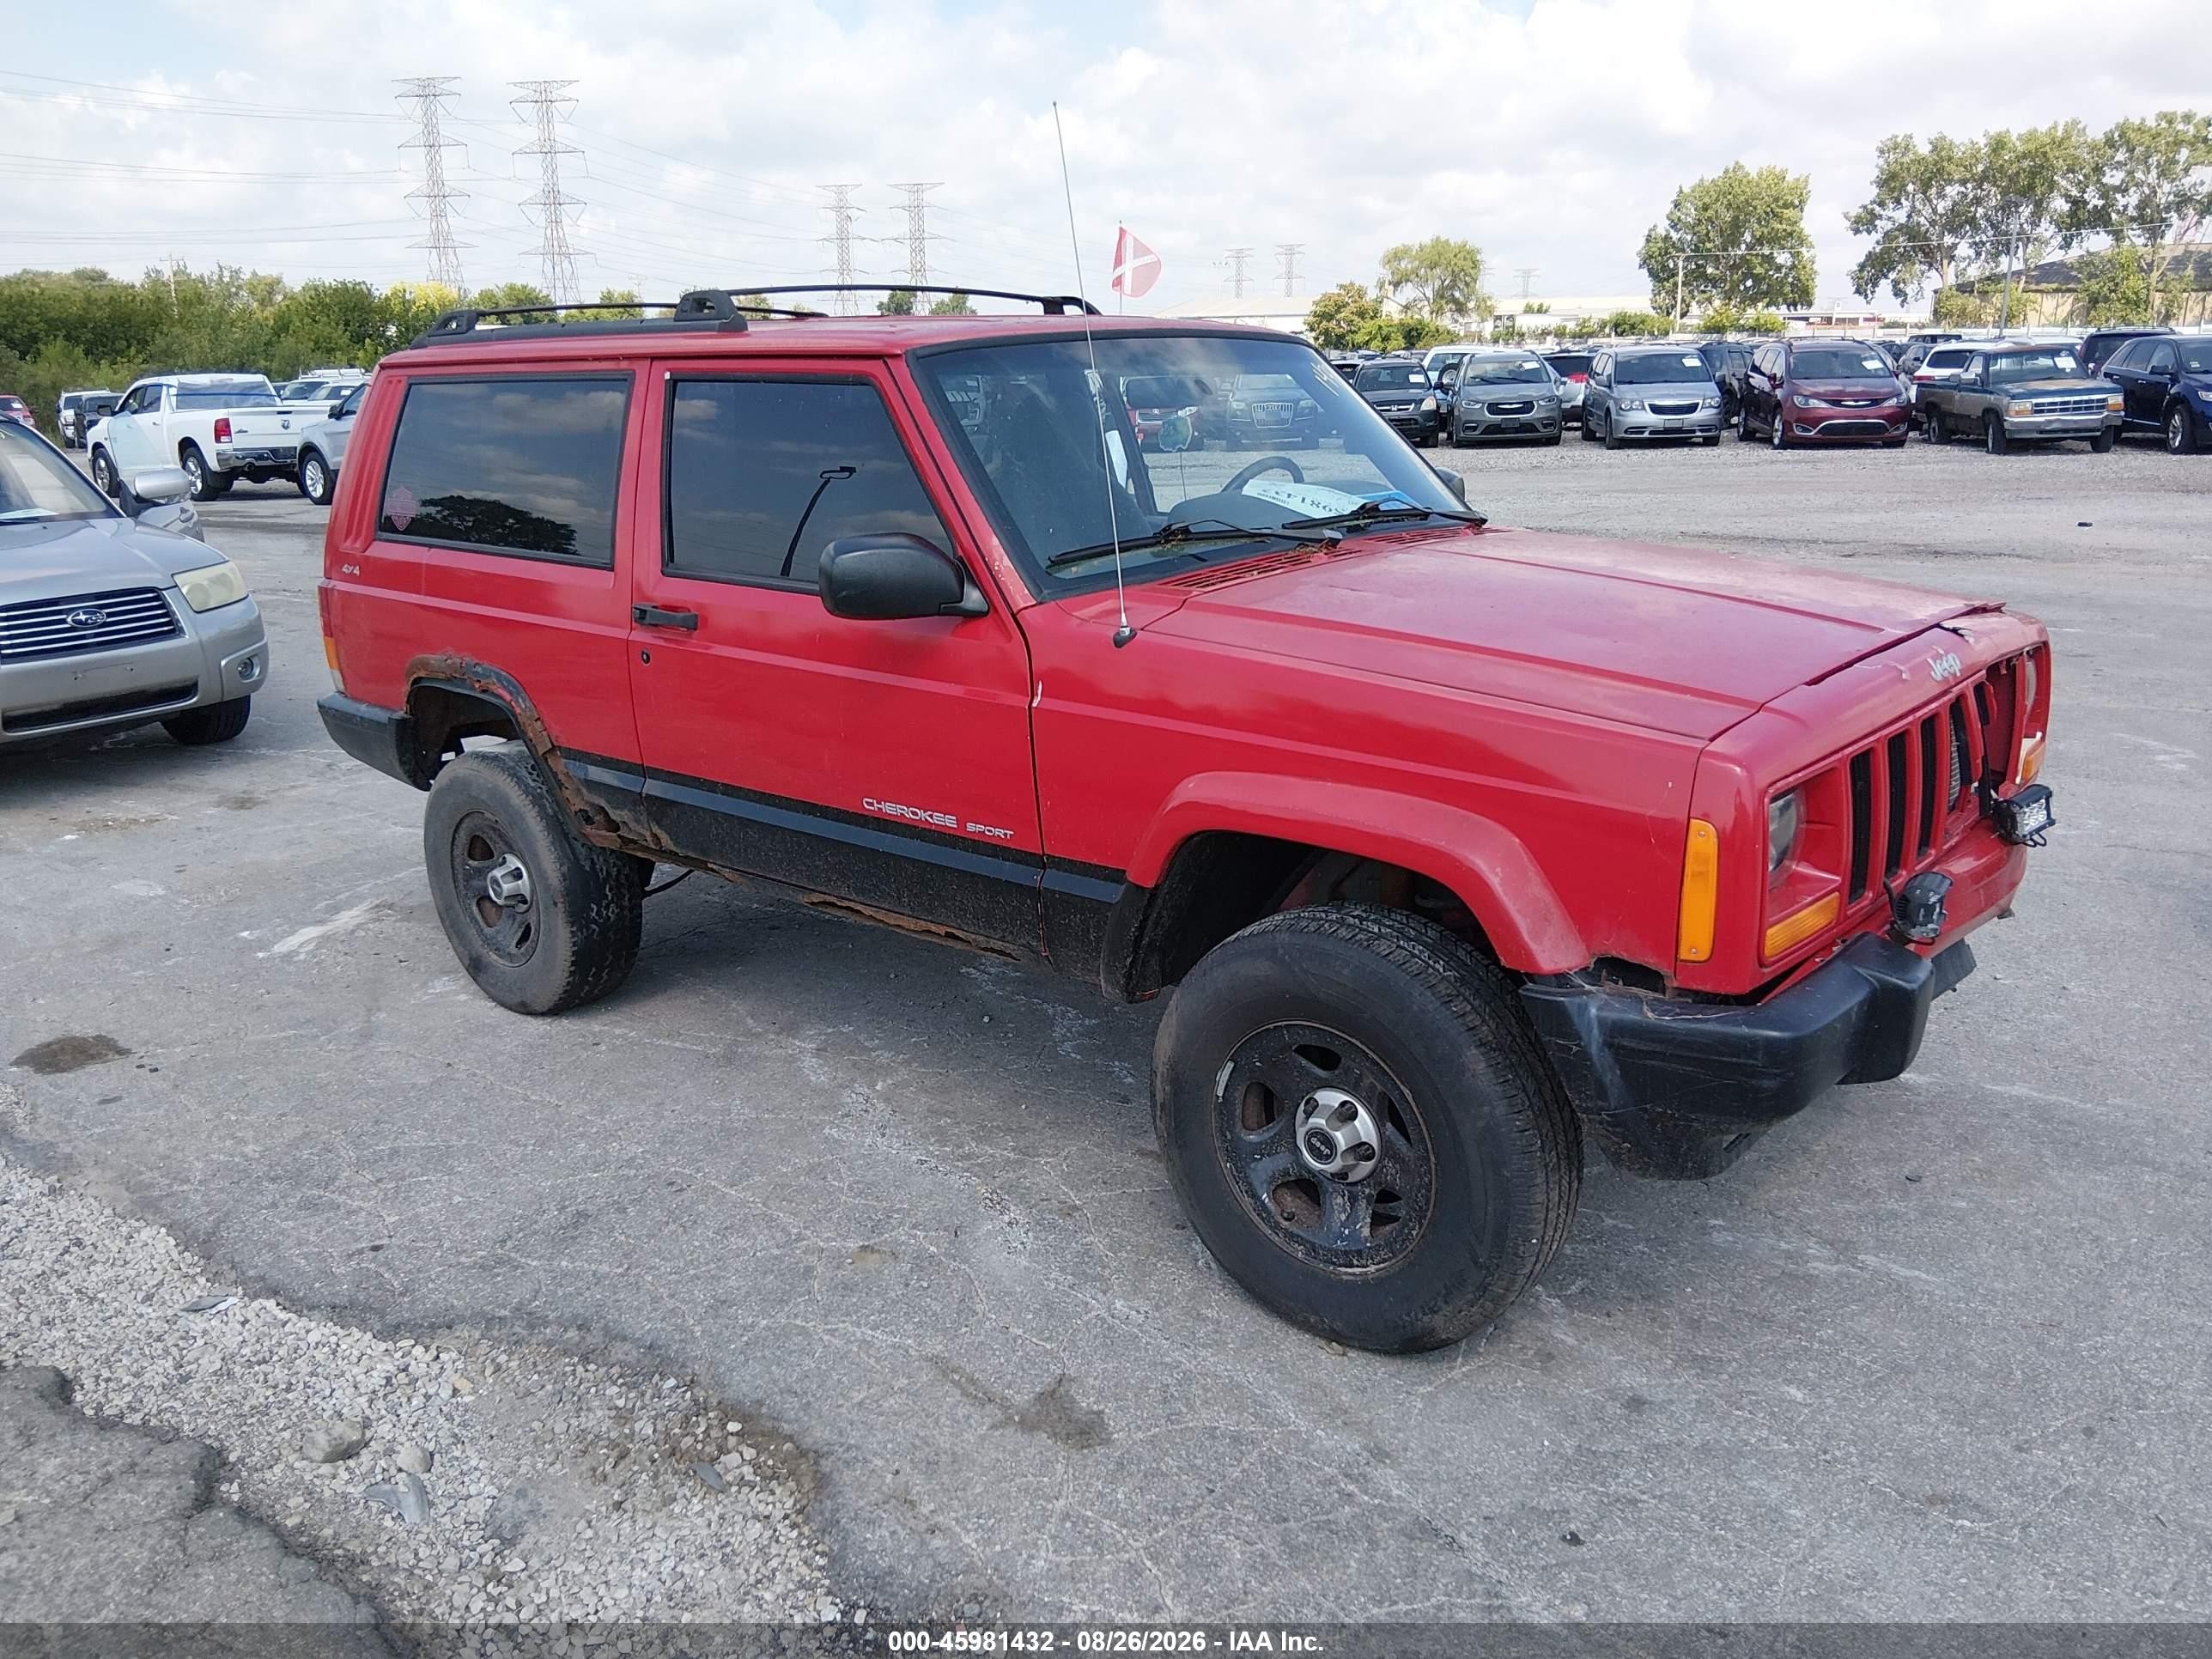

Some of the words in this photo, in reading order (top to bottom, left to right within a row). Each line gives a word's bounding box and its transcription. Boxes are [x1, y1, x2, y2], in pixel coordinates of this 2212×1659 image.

[1925, 652, 1961, 682] Jeep
[861, 797, 958, 829] CHEROKEE
[965, 822, 1014, 840] SPORT
[1310, 1136, 1331, 1156] Jeep
